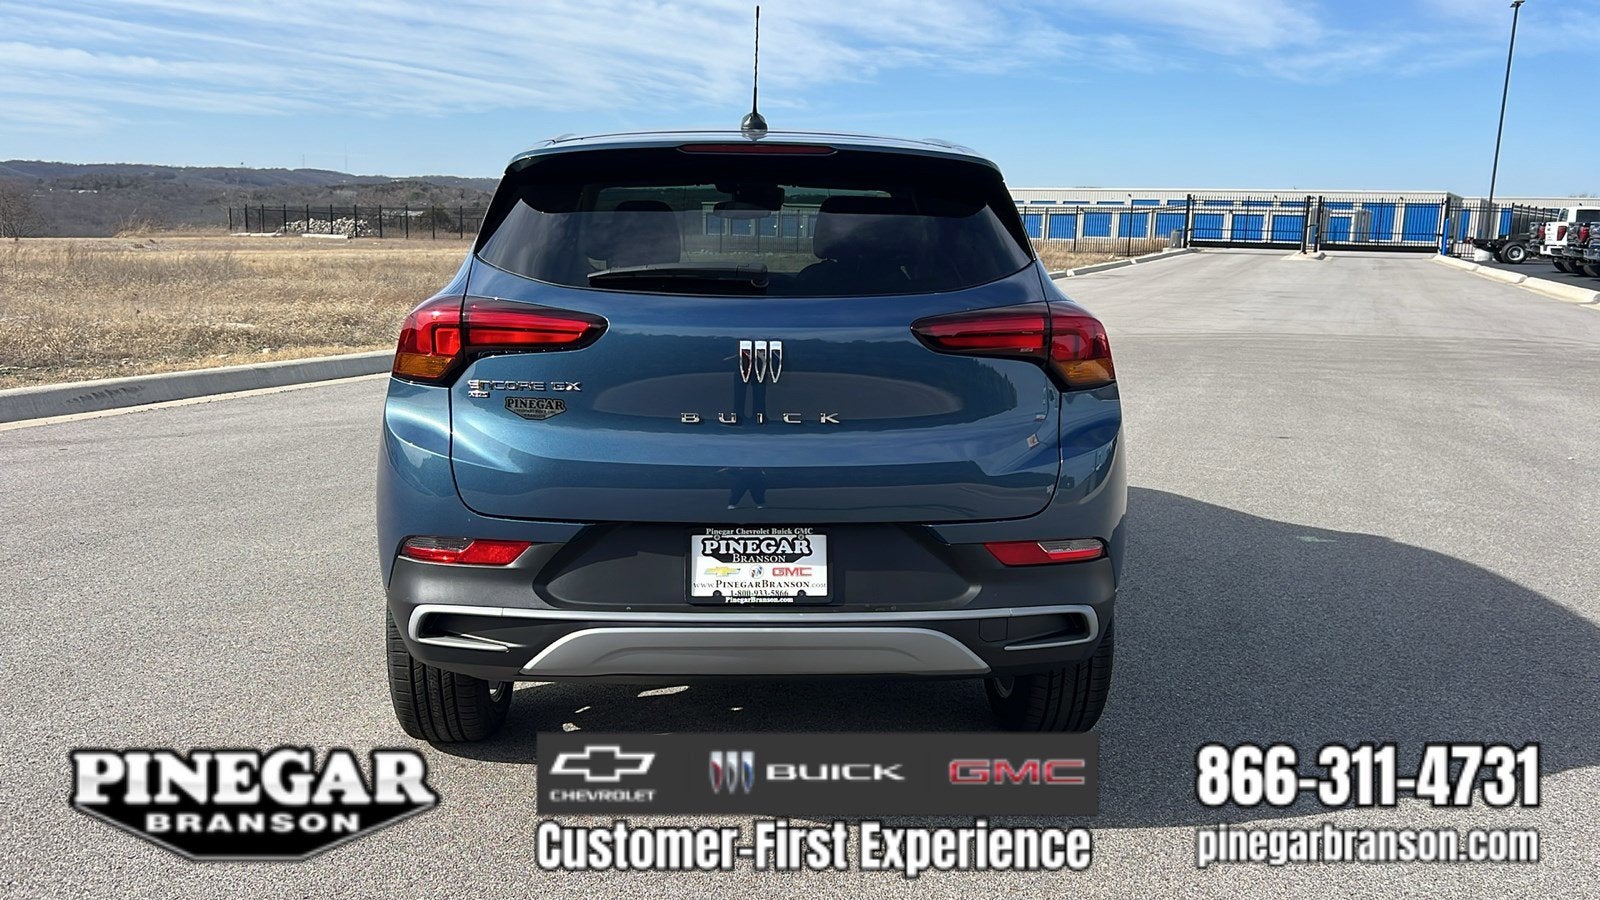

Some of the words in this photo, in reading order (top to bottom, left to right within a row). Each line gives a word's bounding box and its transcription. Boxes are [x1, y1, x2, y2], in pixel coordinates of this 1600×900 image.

[467, 380, 546, 390] ENCORE
[551, 381, 581, 391] GX
[506, 398, 565, 410] PINEGAR
[680, 412, 840, 424] BUICK
[705, 528, 734, 536] Pinegar
[703, 540, 811, 554] PINEGAR
[772, 567, 813, 577] GMC
[730, 589, 789, 597] 1-800-933-5866
[725, 596, 794, 604] PinegarBranson.com
